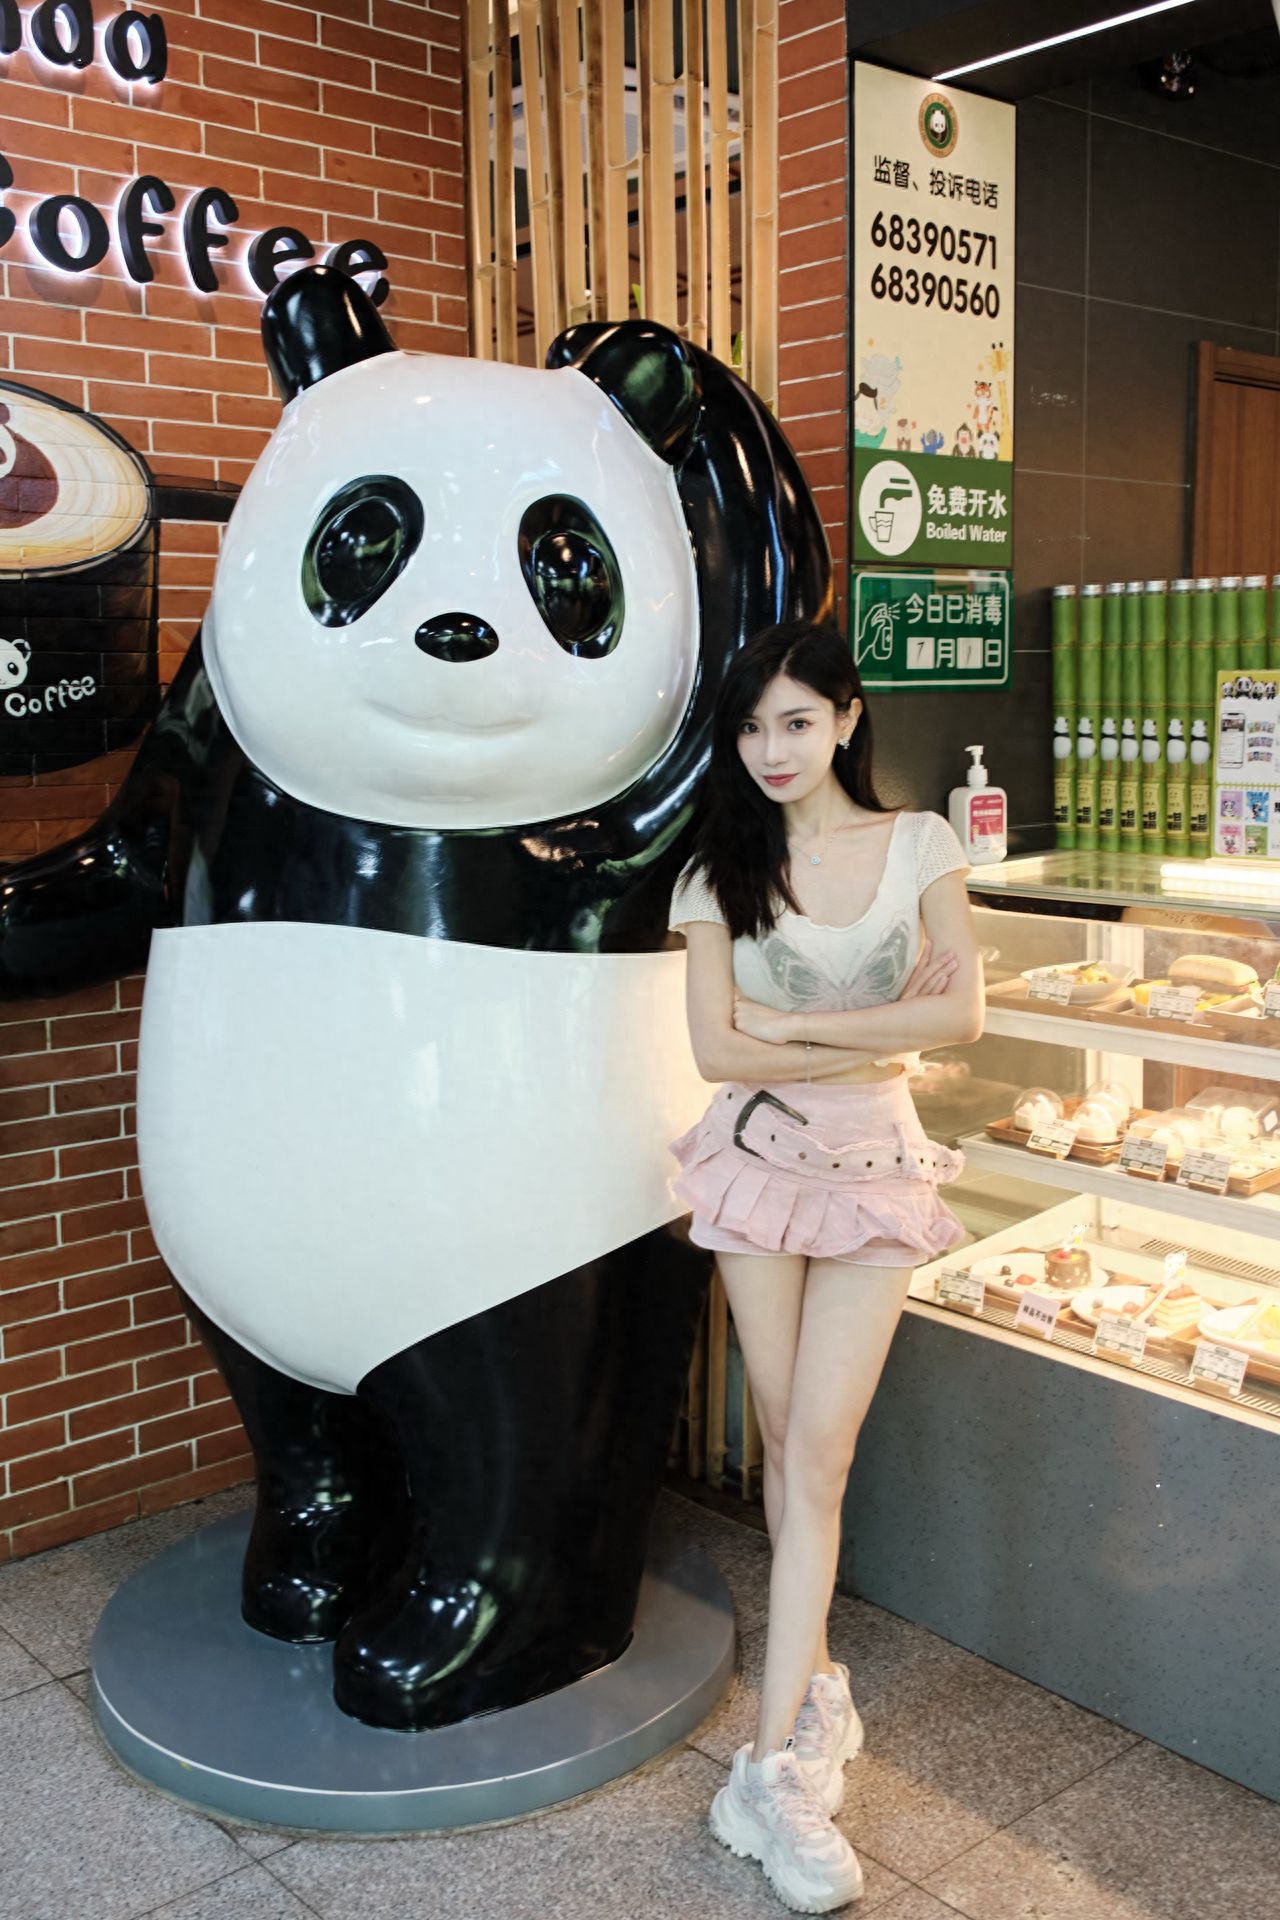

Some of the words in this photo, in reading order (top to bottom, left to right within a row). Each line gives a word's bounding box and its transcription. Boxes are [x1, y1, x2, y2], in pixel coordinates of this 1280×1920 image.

[873, 155, 998, 209] 监督、投诉电话
[0, 154, 390, 308] offee
[871, 211, 997, 270] 68390571
[871, 263, 1000, 319] 68390560
[926, 484, 1007, 519] 免费开水
[926, 522, 966, 541] Boiled
[969, 525, 1007, 543] Water
[905, 593, 1002, 626] 今日已消毒
[4, 675, 96, 717] Coffee
